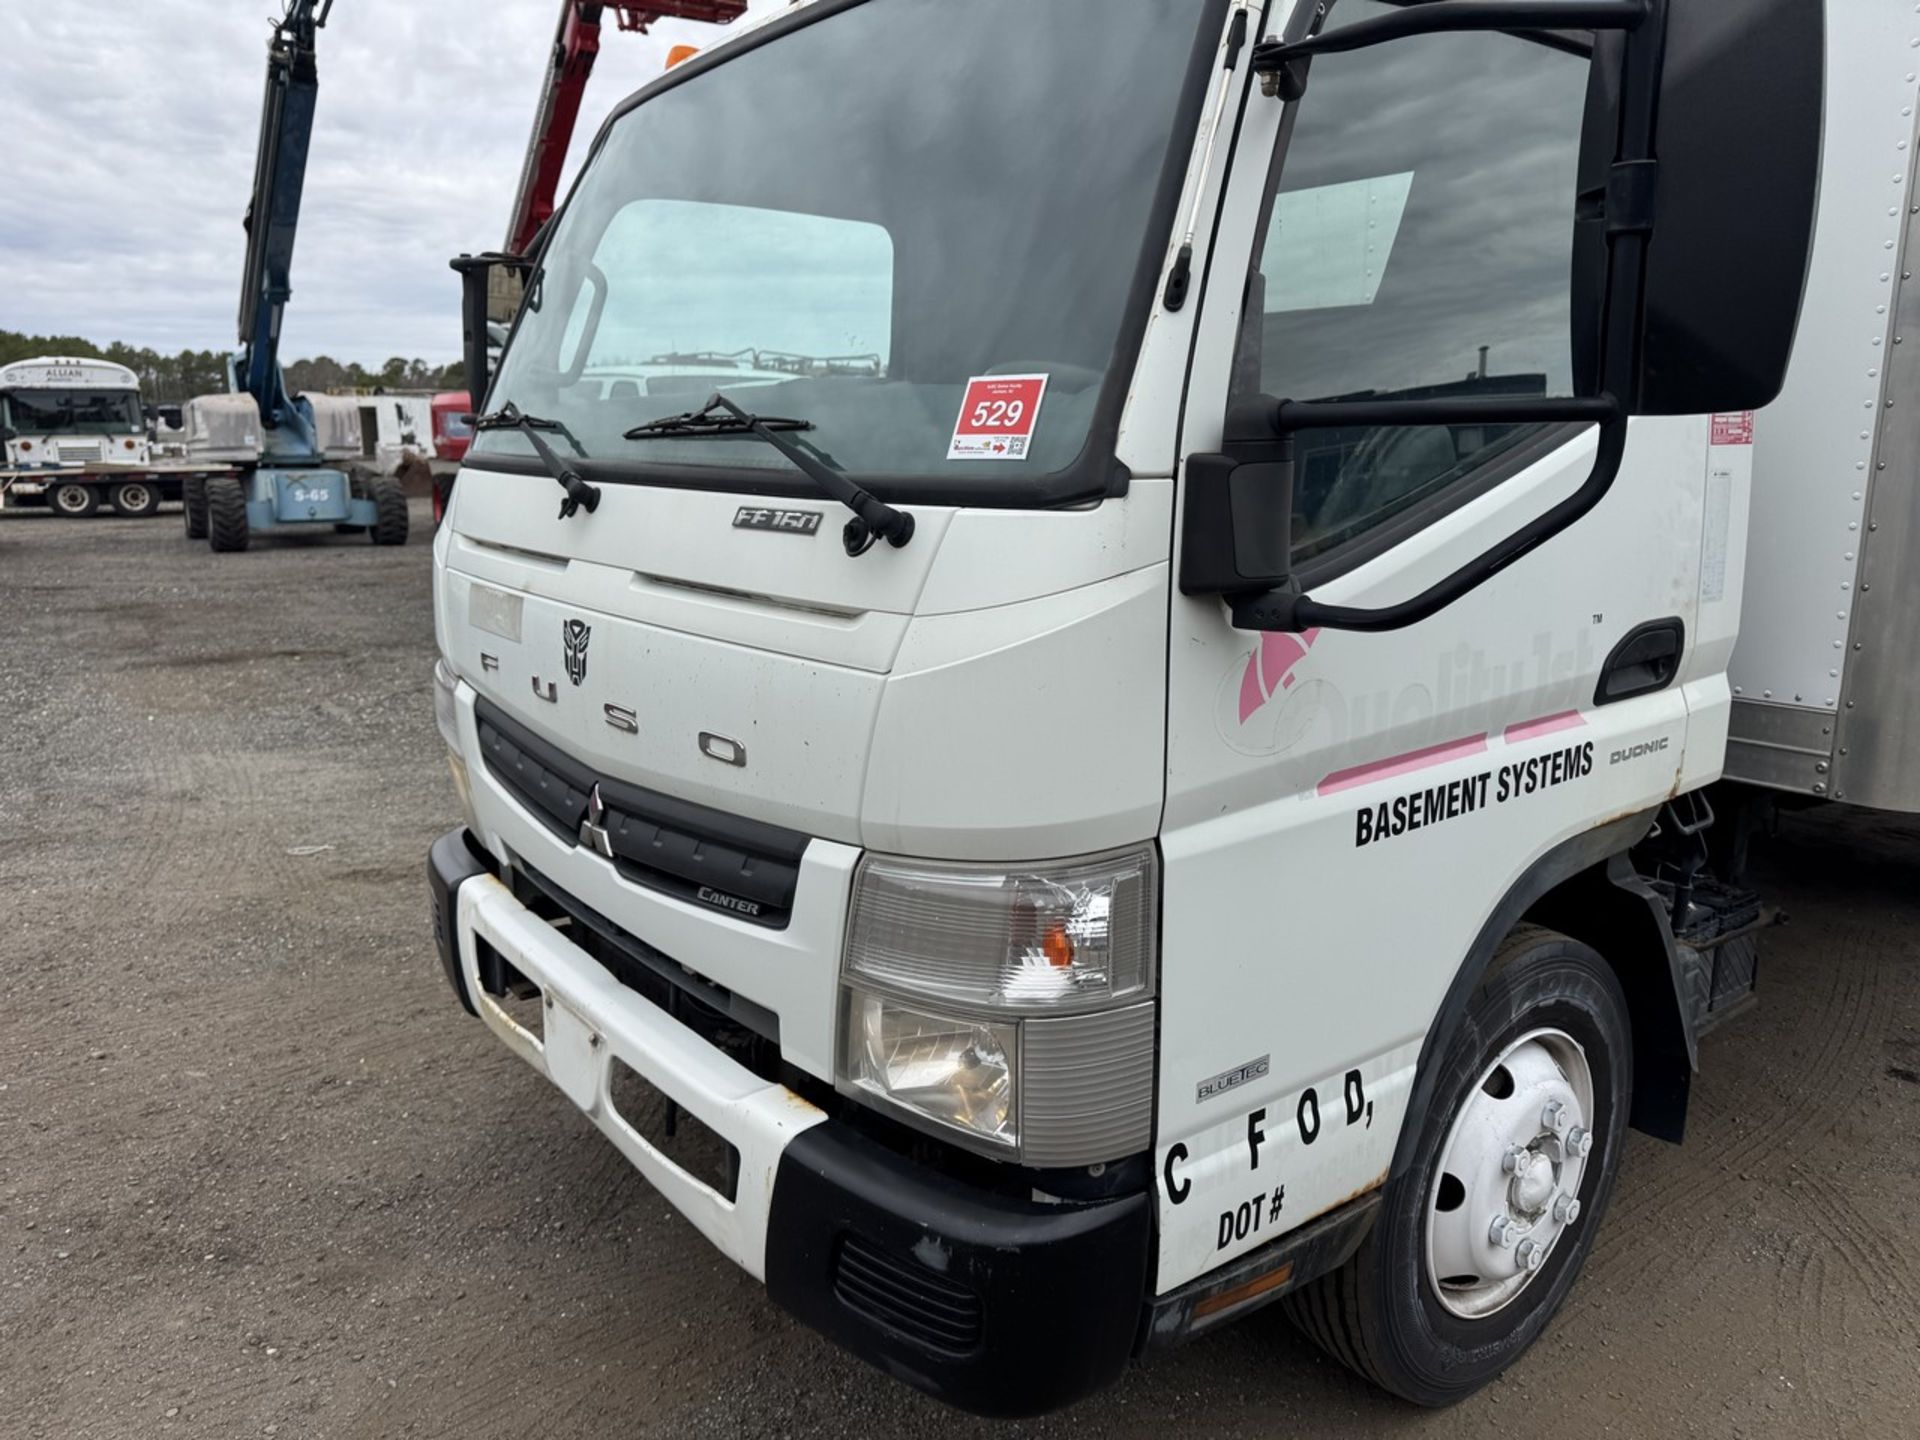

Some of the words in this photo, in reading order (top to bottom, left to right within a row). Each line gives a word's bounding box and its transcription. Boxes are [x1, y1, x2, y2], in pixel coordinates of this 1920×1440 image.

[971, 400, 1024, 427] 529
[295, 489, 329, 501] S-65
[1609, 736, 1669, 765] DUONIC
[1355, 771, 1491, 848] BASEMENT
[1496, 741, 1594, 803] SYSTEMS
[696, 886, 759, 915] CANTER
[1217, 1193, 1266, 1250] DOT
